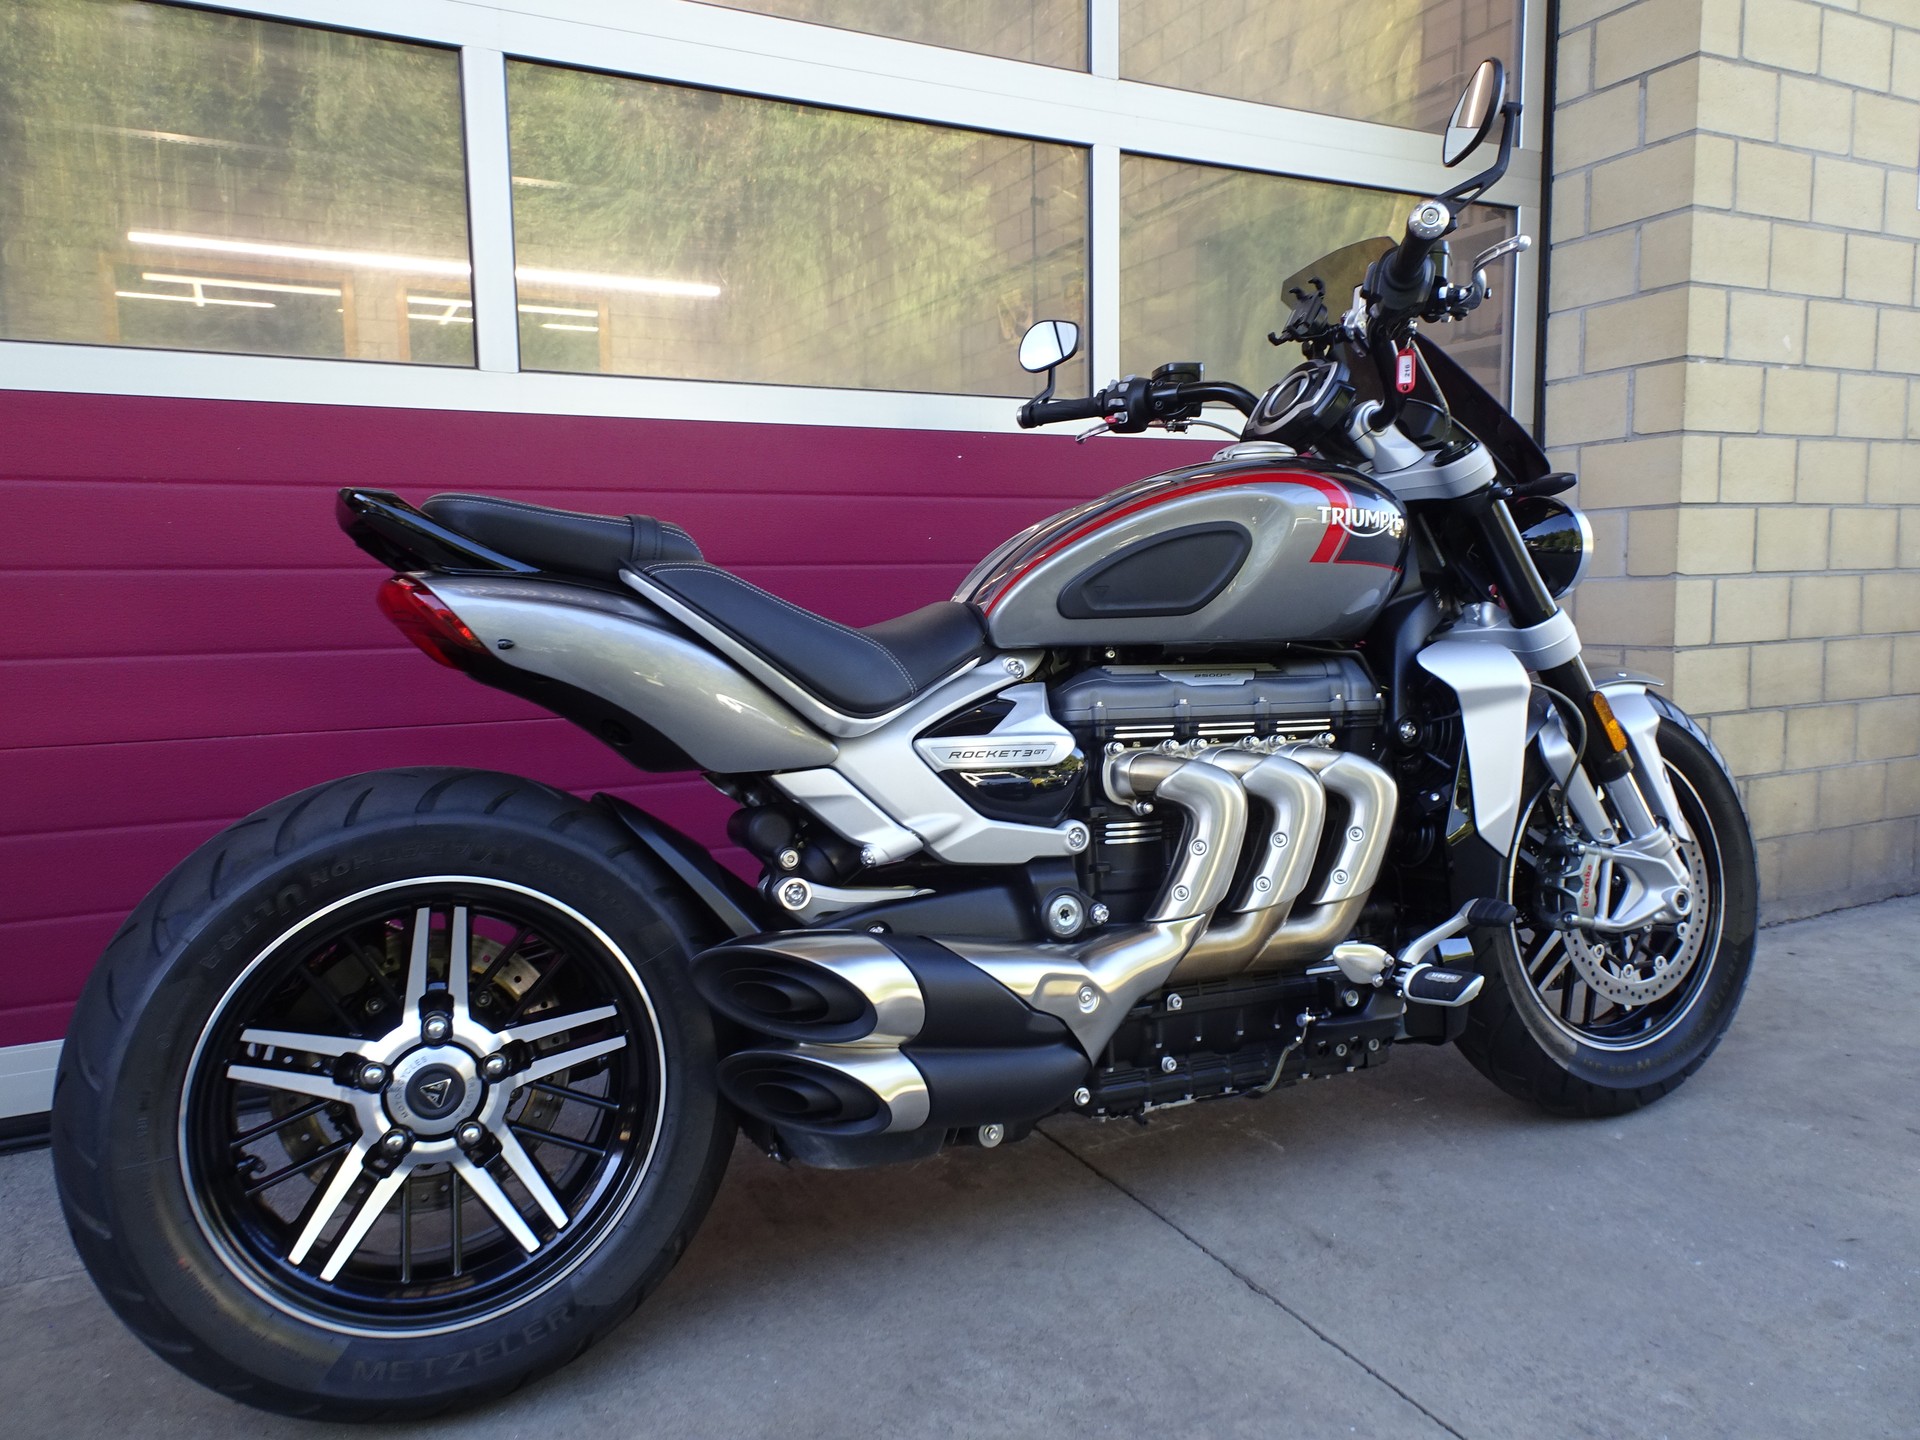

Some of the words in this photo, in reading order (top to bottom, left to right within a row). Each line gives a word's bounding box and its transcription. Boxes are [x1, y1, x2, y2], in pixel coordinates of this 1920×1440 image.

[1317, 506, 1402, 537] TRIUMPH
[1582, 864, 1593, 907] brembo
[352, 1304, 575, 1382] METZELER
